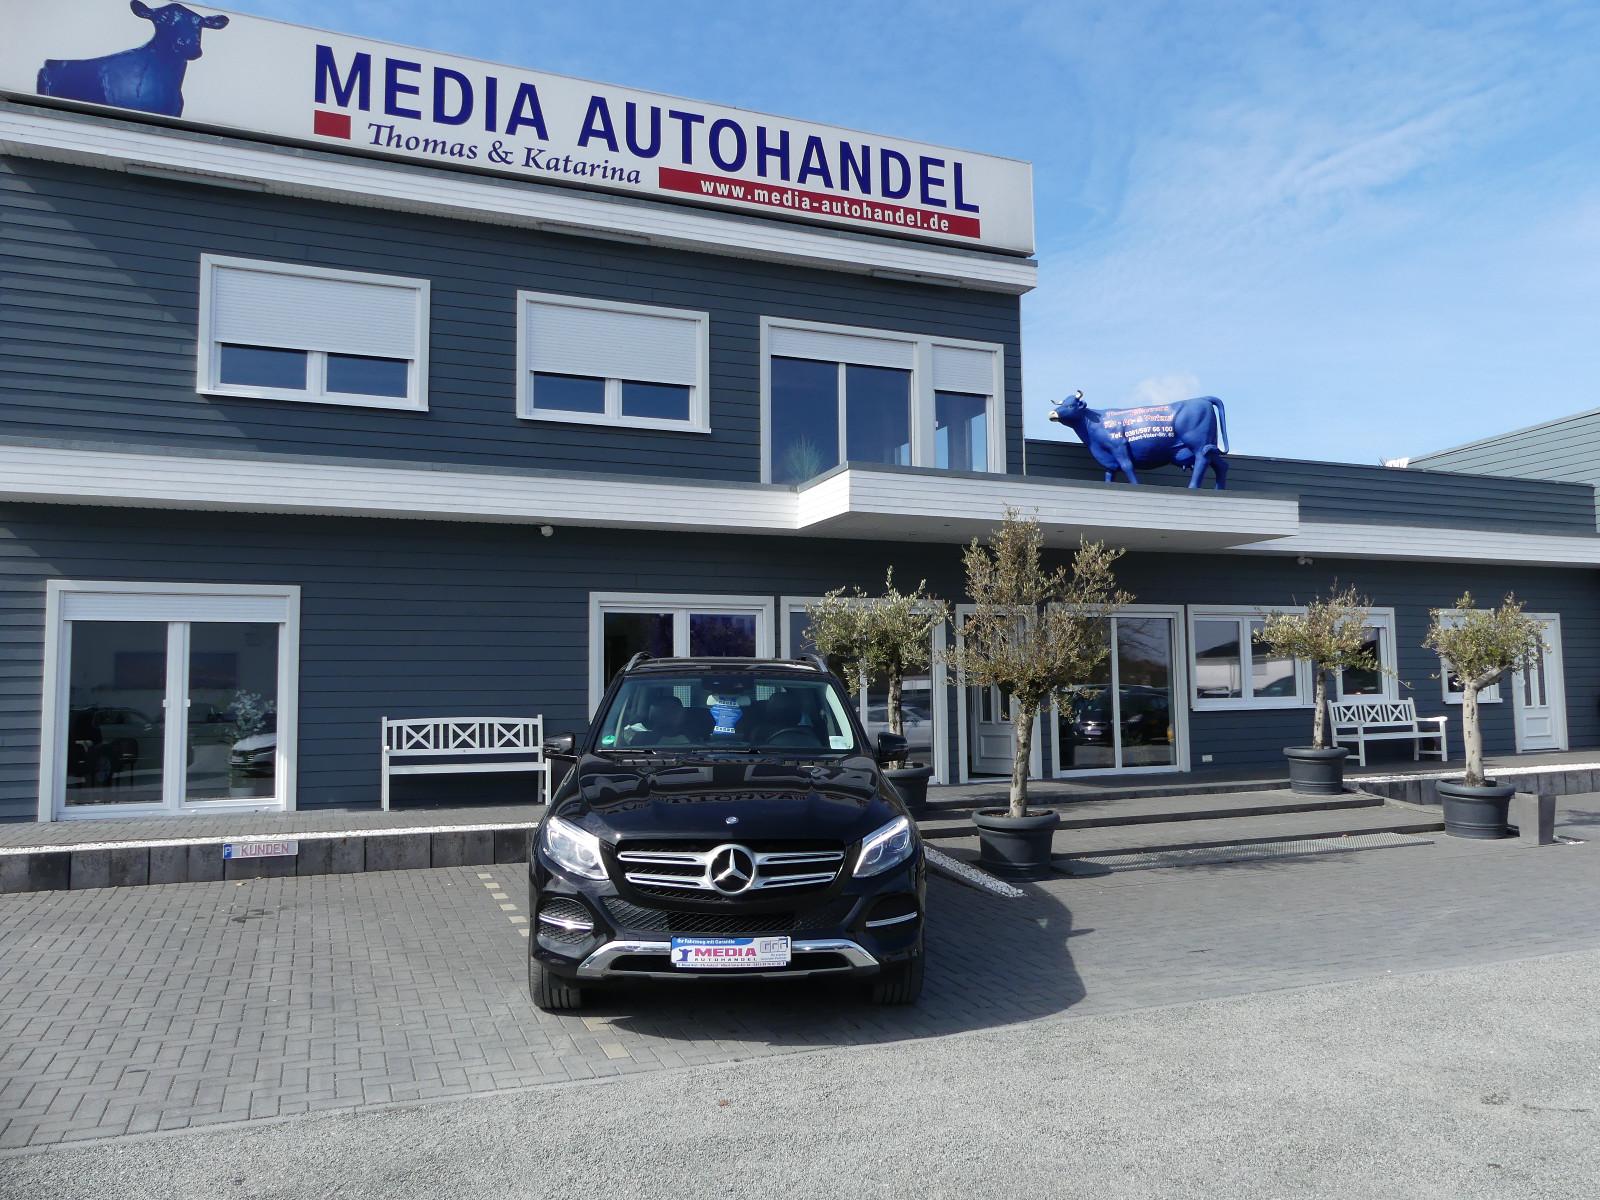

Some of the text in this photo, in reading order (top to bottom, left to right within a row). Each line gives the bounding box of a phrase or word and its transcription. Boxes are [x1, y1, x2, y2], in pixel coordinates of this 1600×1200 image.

[314, 44, 980, 214] MEDIA AUTOHANDEL
[368, 122, 641, 184] Thomas & Katarina
[700, 178, 949, 232] www.media-autohandel.de
[241, 843, 289, 857] KUNDEN
[694, 947, 757, 957] MEDIA
